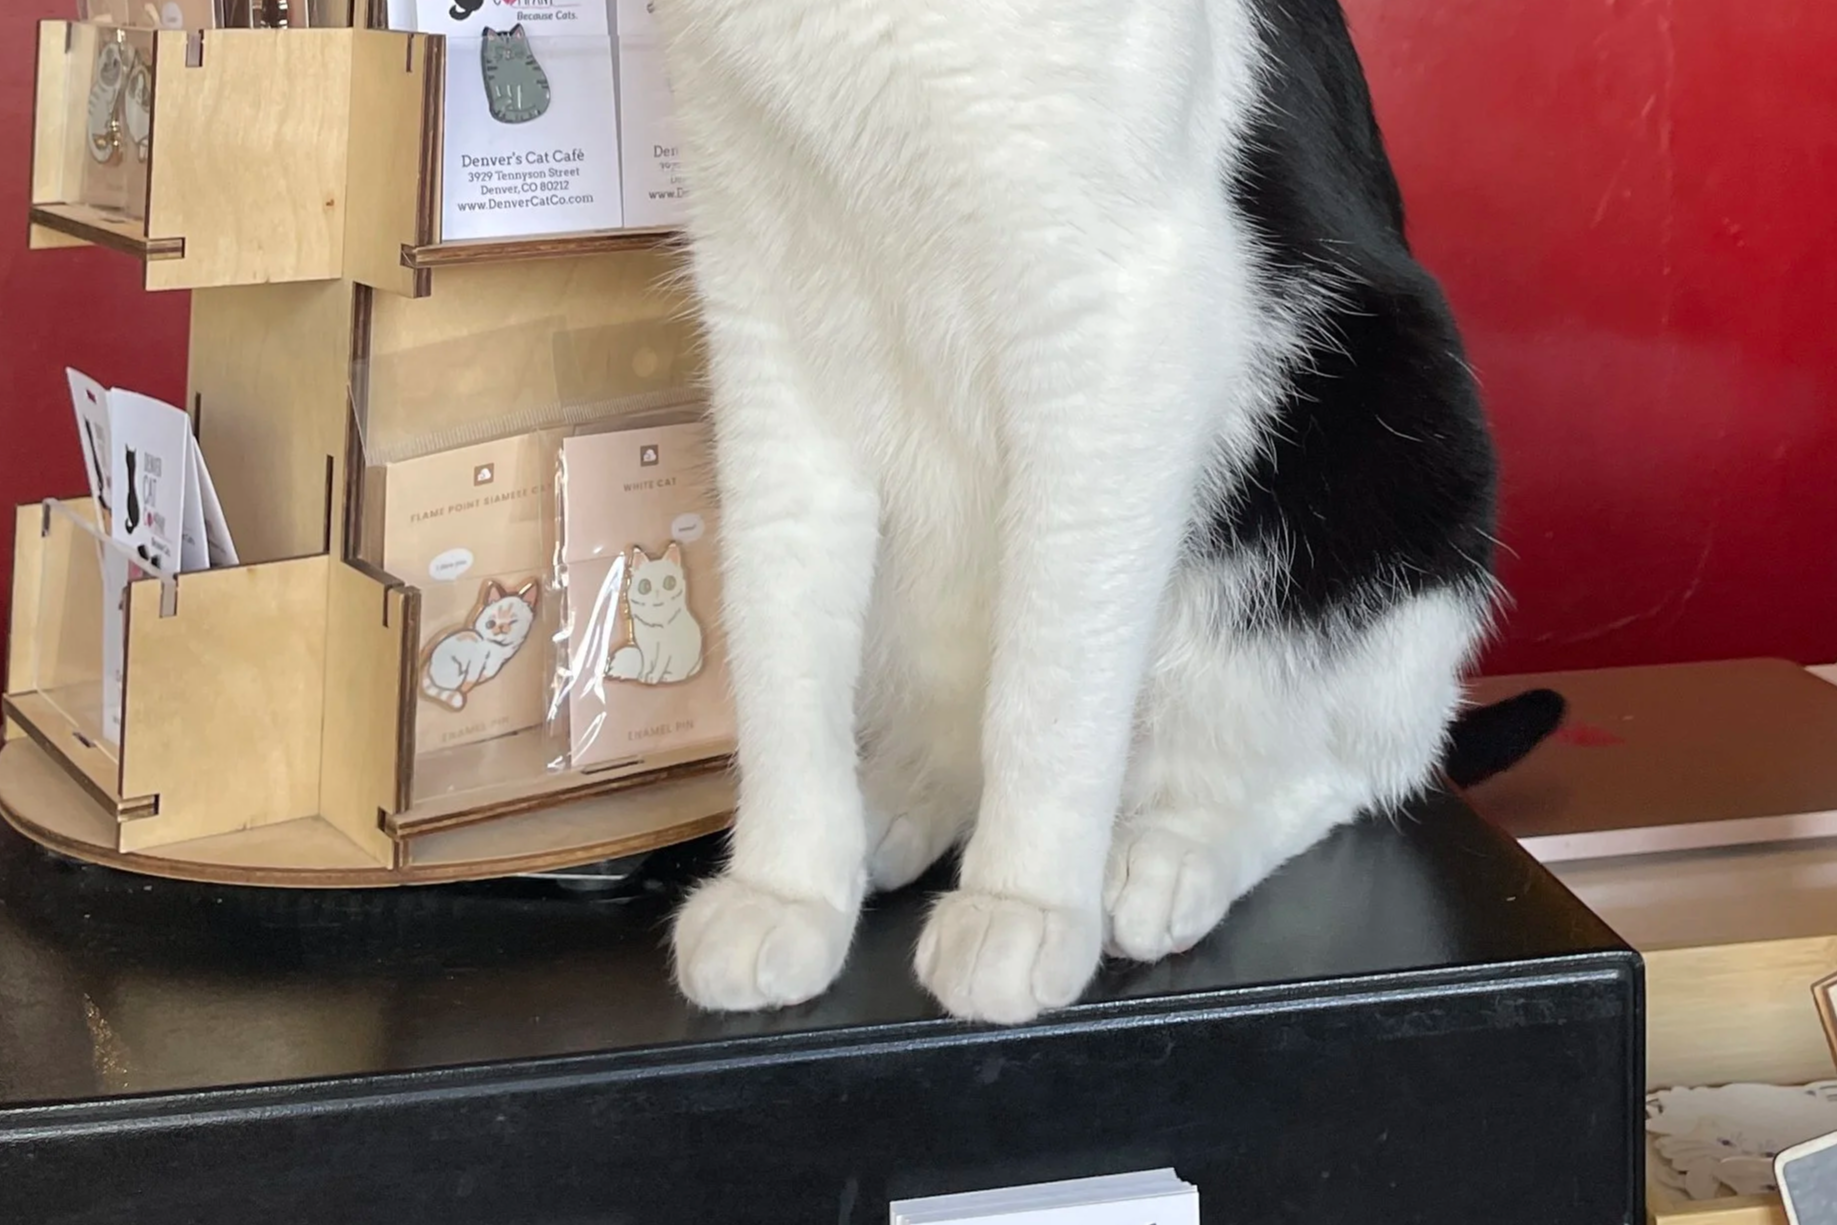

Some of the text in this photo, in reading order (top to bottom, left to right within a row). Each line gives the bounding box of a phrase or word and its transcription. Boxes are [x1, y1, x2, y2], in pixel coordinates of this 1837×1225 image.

[517, 10, 553, 21] Because
[461, 148, 585, 168] Denver's Cat Café
[468, 167, 580, 183] 3929 Tennyson Street
[539, 180, 569, 192] 80212
[457, 193, 594, 211] www.DenverCatCo.com
[623, 477, 676, 492] WHITE CAT
[410, 507, 445, 523] FLAME
[447, 499, 481, 514] POINT
[483, 489, 528, 506] SIAMESE
[627, 720, 695, 741] ENAMEL PIN
